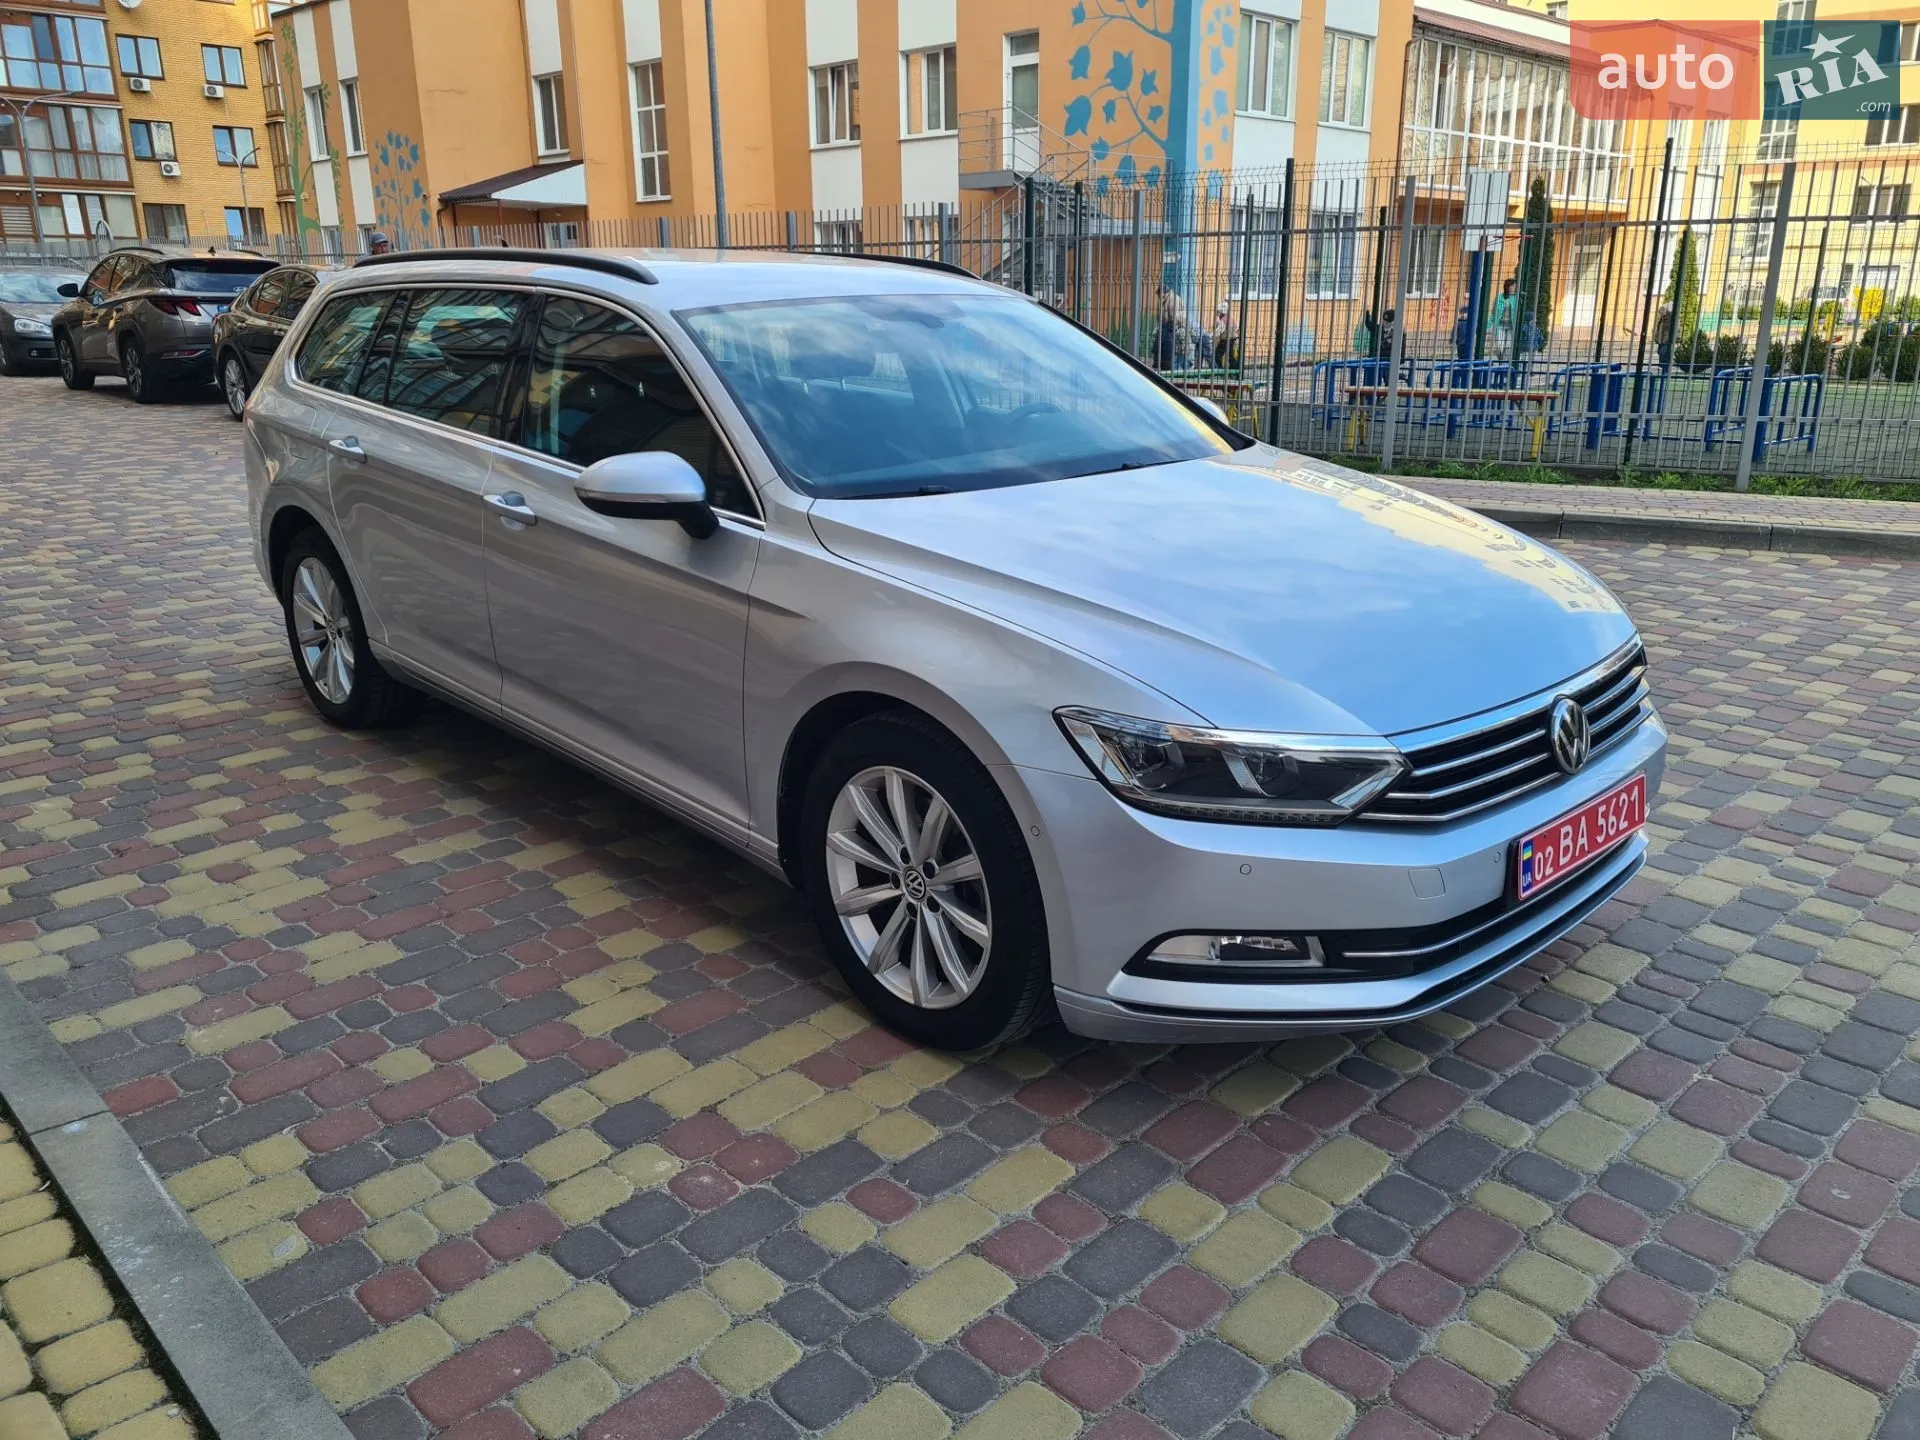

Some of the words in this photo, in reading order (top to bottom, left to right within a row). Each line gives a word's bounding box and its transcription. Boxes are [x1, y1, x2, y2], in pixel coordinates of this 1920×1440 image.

[1535, 846, 1554, 881] 02
[1559, 815, 1588, 867] BA
[1596, 785, 1639, 843] 5621
[1522, 872, 1532, 887] UA
